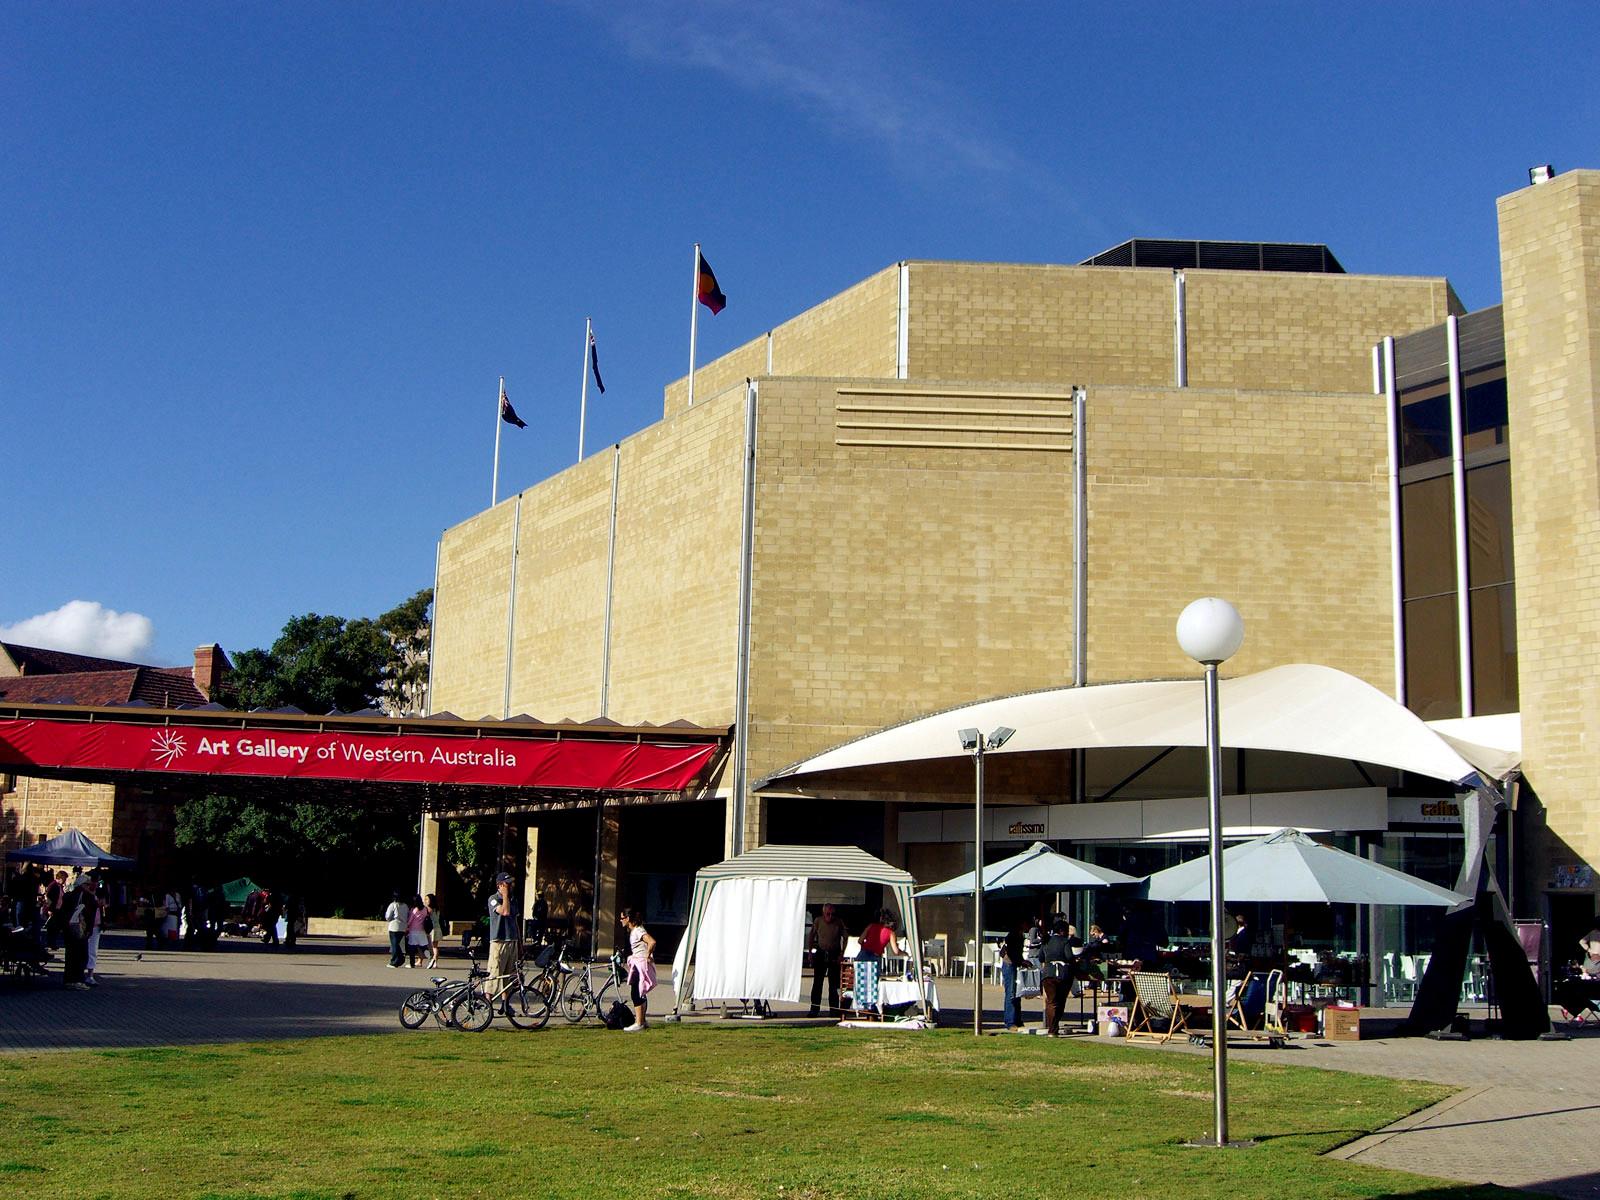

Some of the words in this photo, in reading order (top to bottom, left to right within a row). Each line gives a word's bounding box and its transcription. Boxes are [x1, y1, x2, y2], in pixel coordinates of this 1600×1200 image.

[197, 737, 230, 755] Art
[236, 739, 309, 764] Gallery
[316, 741, 337, 760] of
[341, 743, 425, 763] Western
[430, 746, 517, 767] Australia
